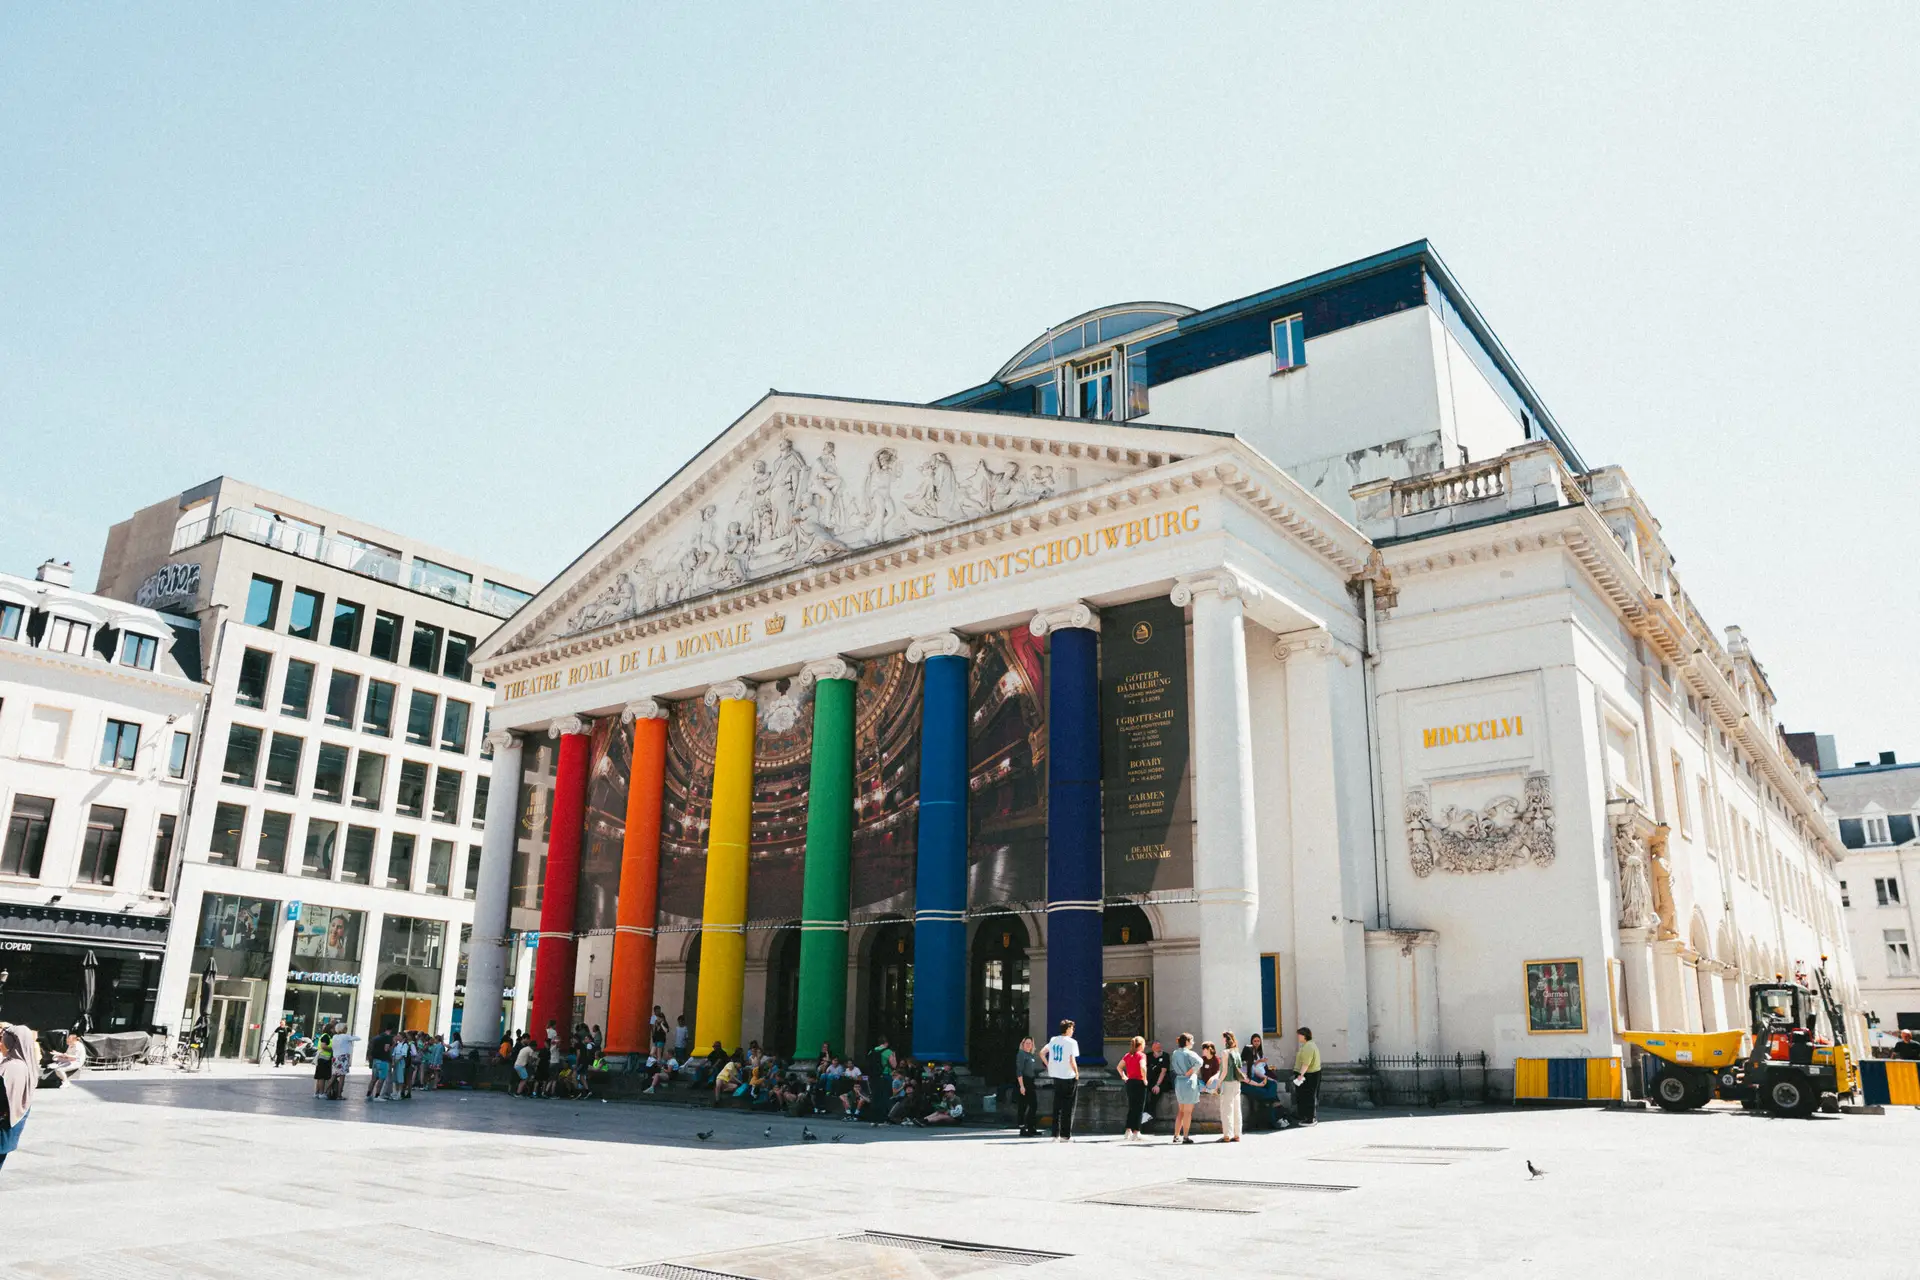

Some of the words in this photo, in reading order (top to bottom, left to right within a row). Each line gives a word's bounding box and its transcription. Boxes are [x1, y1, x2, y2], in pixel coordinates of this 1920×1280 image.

[802, 572, 936, 628] KONINKLIJKE
[947, 505, 1201, 591] MUNTSCHOUWBURG
[503, 671, 561, 701] THEATRE
[568, 658, 612, 687] ROYAL
[619, 650, 640, 673] DE
[647, 643, 667, 666] LA
[676, 621, 752, 659] MONNAIE
[1120, 709, 1174, 725] GROTTESCHI
[1423, 716, 1523, 749] MDCCCLVI
[1130, 757, 1162, 769] BOVARY
[1128, 790, 1165, 801] CARMEN
[1142, 843, 1165, 853] MUNT
[1125, 853, 1135, 862] LA
[1136, 849, 1172, 861] MONNAIE
[1543, 990, 1569, 998] Carmen
